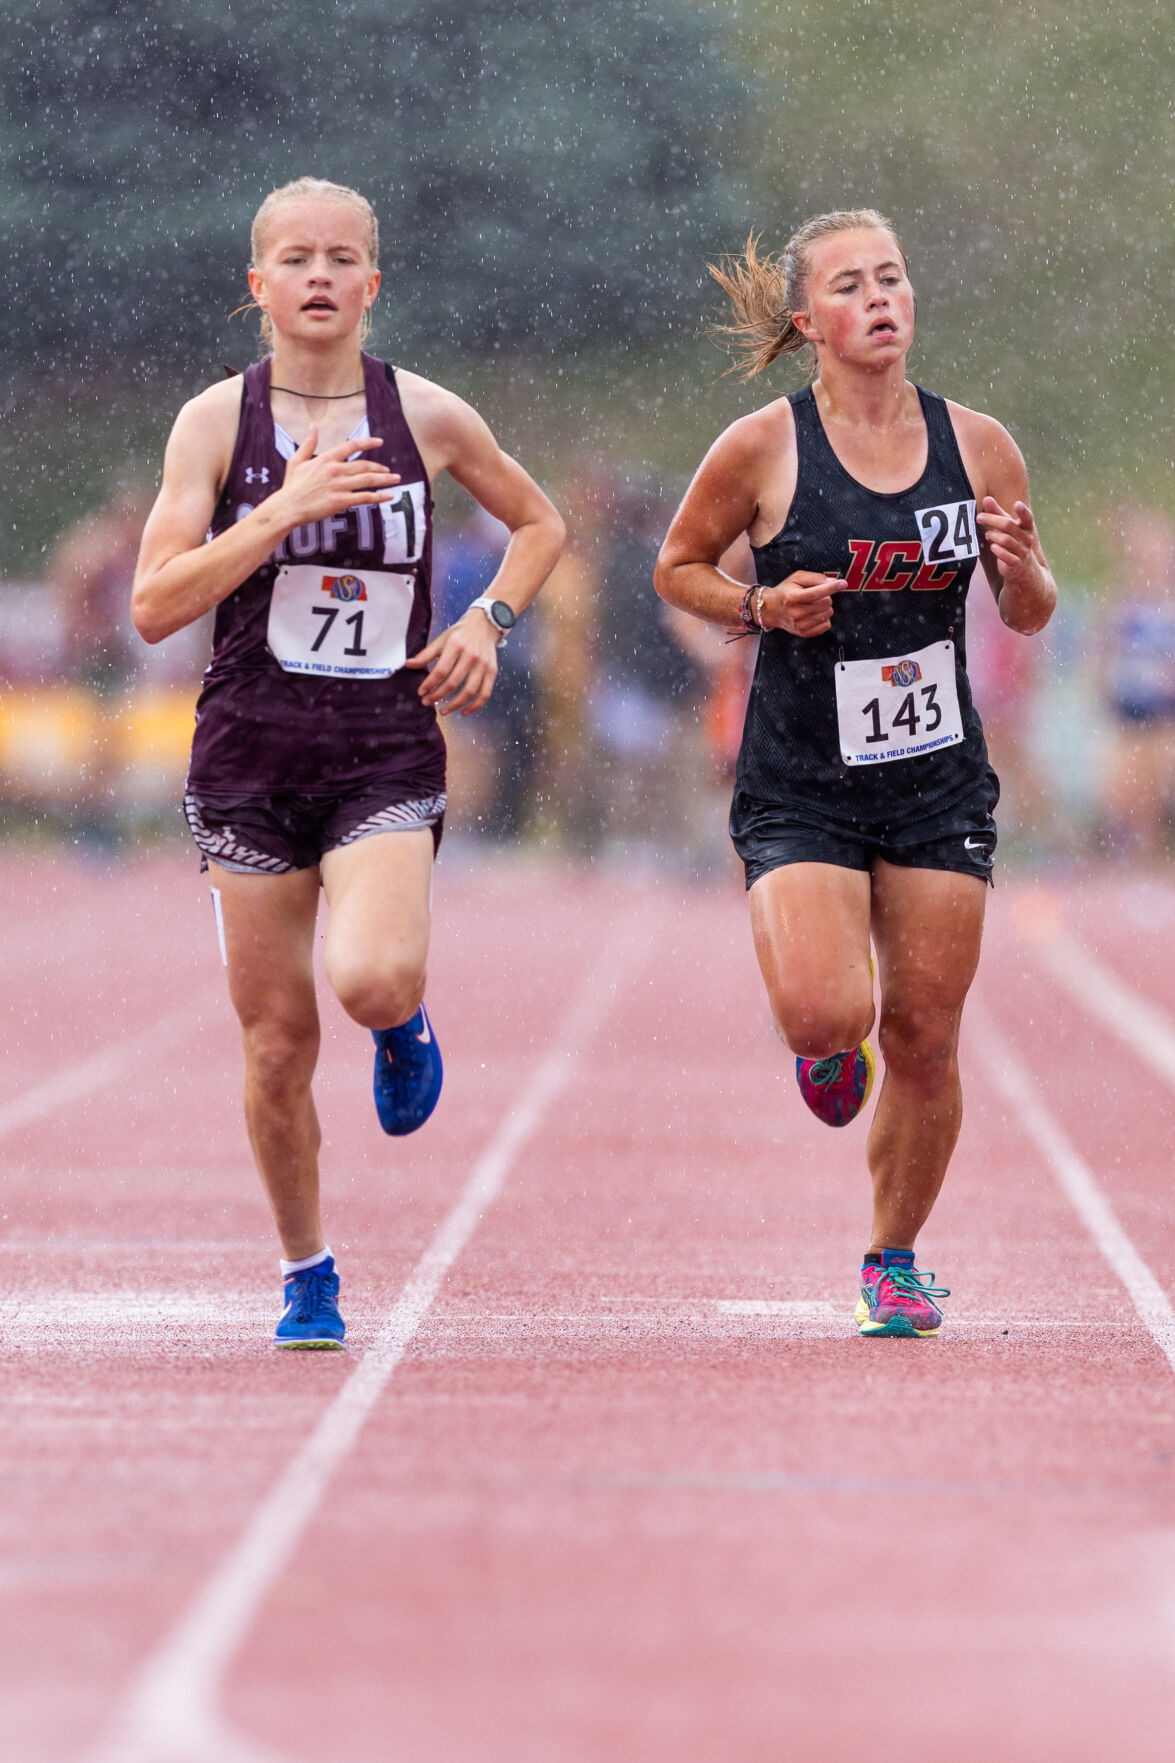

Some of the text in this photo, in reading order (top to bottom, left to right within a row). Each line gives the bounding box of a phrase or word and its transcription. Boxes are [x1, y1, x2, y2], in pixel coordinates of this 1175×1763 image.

[391, 490, 416, 558] 1
[921, 503, 973, 562] 24
[311, 606, 368, 657] 71
[279, 659, 393, 675] TRACK & FIELD CHAMPIONSHIPS
[861, 683, 943, 744] 143
[855, 734, 954, 763] TRACK & FIELD CHAMPIONSHIPS
